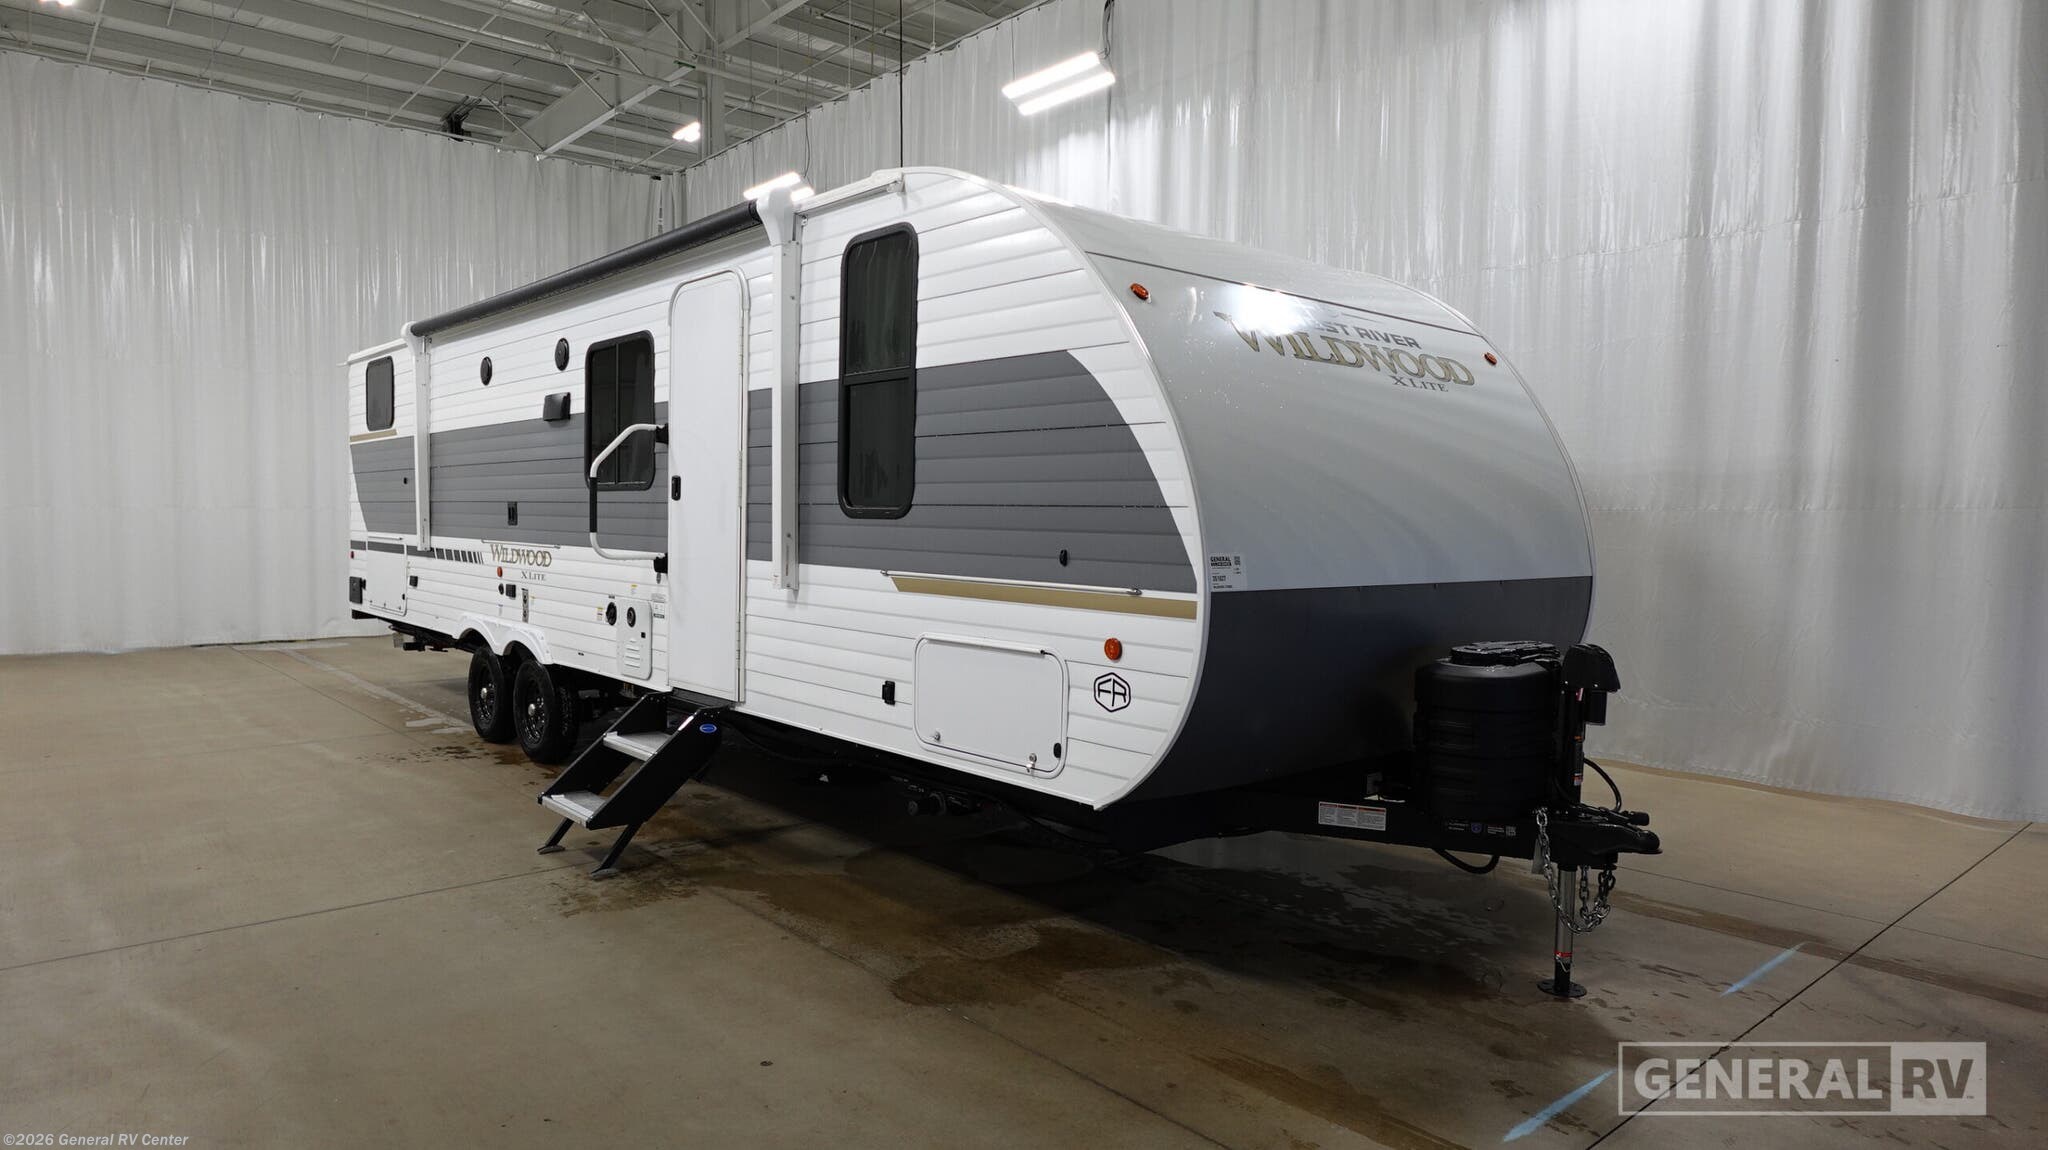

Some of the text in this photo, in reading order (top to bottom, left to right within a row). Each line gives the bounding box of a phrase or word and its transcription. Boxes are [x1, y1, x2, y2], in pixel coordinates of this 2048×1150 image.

[1212, 311, 1474, 386] WILDWOOD
[1352, 326, 1422, 349] RIVER
[489, 543, 552, 568] WILDWOOD
